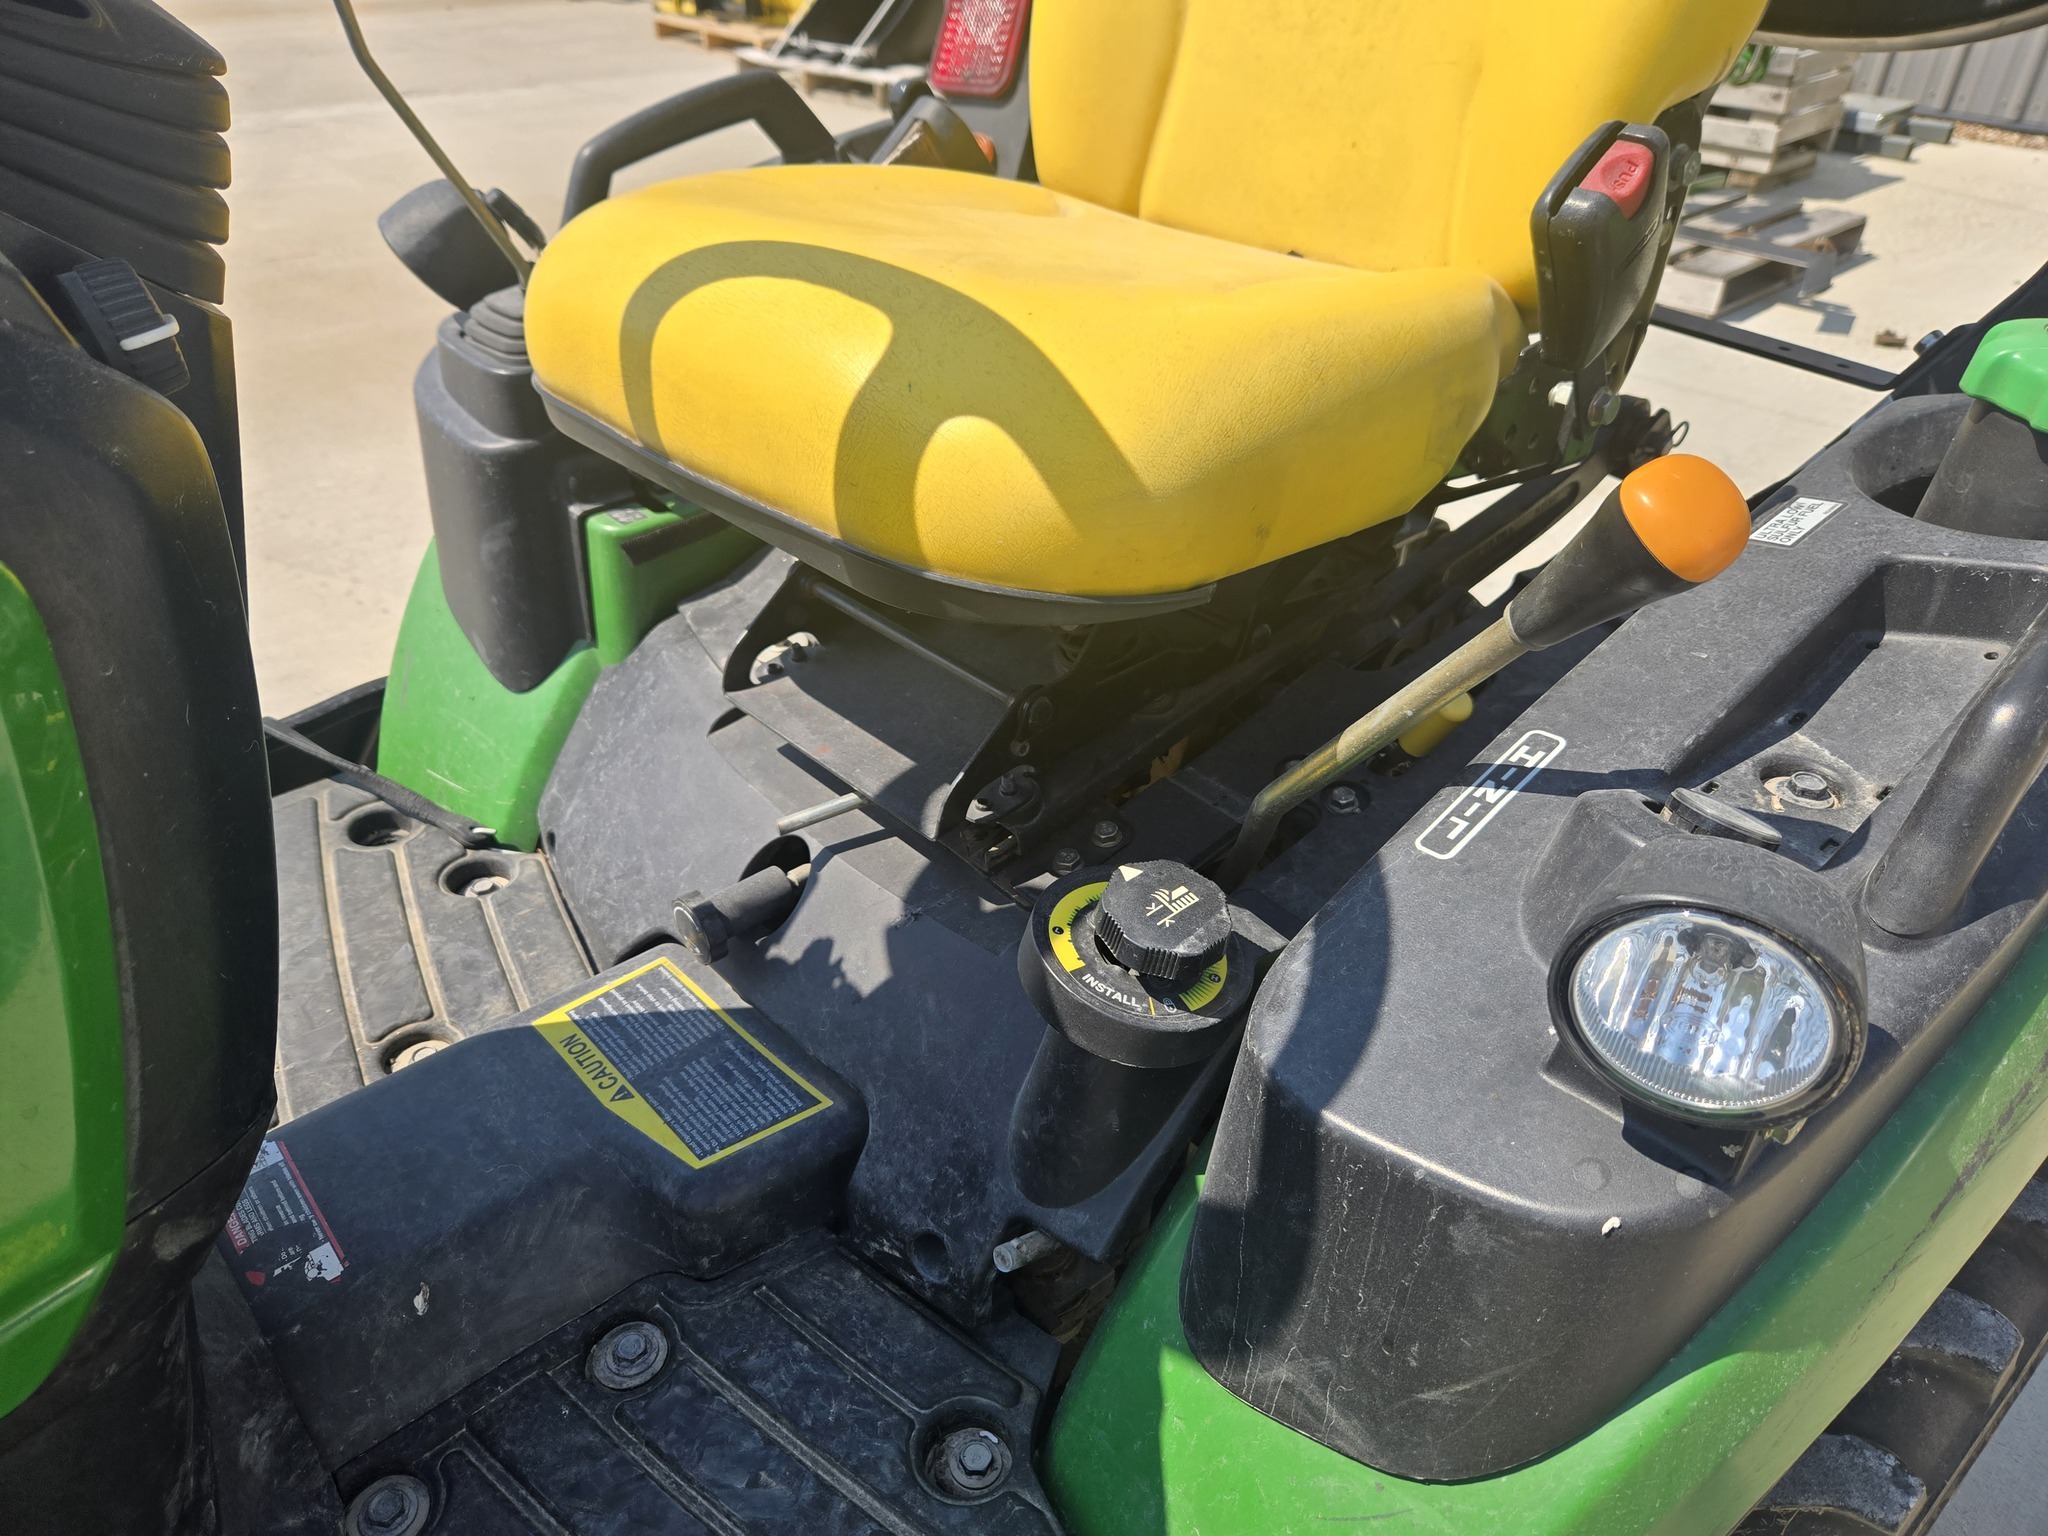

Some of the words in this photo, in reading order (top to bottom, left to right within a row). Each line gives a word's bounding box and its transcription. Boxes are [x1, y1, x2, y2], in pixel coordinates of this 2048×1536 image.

[1755, 519, 1785, 538] ULTRA
[1767, 516, 1804, 541] SULFUR
[1800, 502, 1824, 518] FUEL
[1779, 527, 1805, 543] ONLY
[1082, 973, 1142, 1011] INSTALL
[559, 1032, 618, 1090] CAUTION
[655, 1104, 673, 1121] Manual
[687, 1140, 703, 1154] Read
[239, 1198, 254, 1212] LEGS
[236, 1209, 254, 1230] BLADES
[246, 1211, 260, 1223] AND
[227, 1212, 248, 1246] DANGE
